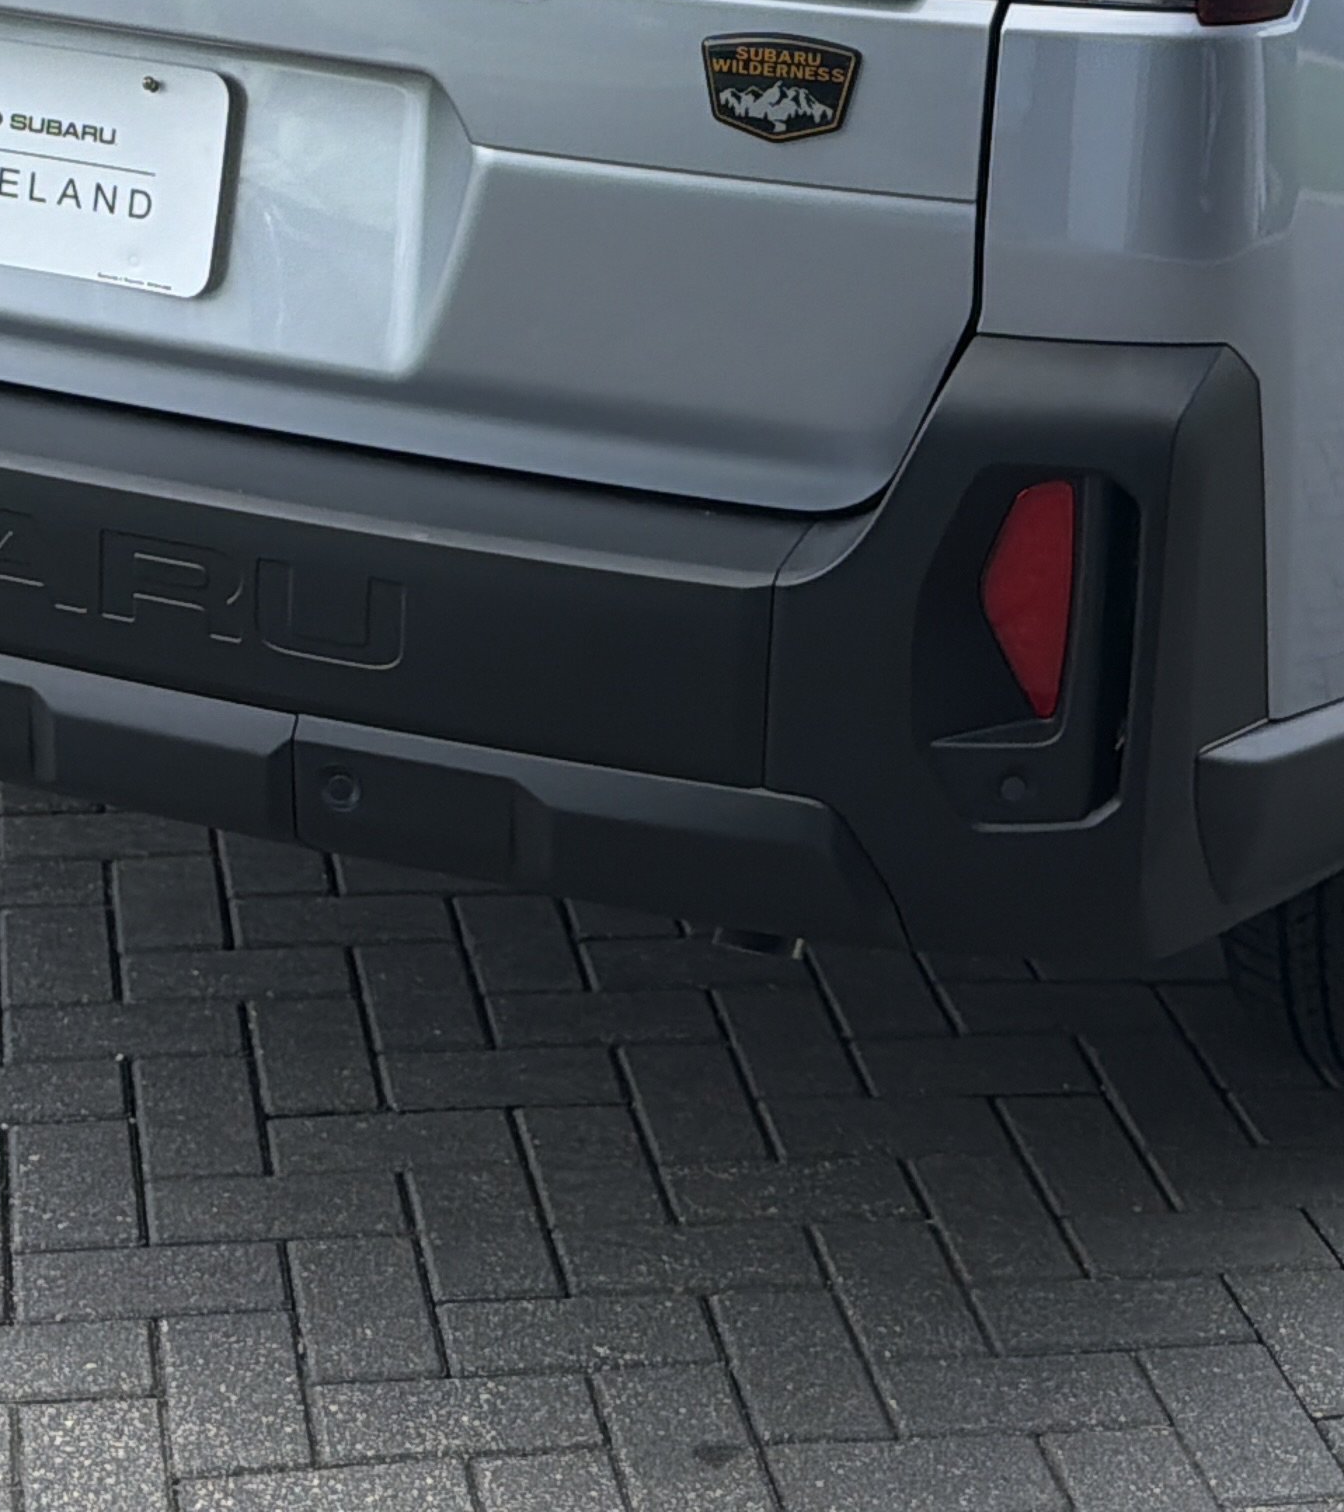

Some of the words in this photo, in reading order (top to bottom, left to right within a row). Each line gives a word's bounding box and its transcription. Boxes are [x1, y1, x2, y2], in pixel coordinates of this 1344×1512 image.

[735, 44, 822, 66] SUBARU
[713, 59, 846, 82] WILDERNESS
[9, 112, 117, 145] SUBARU
